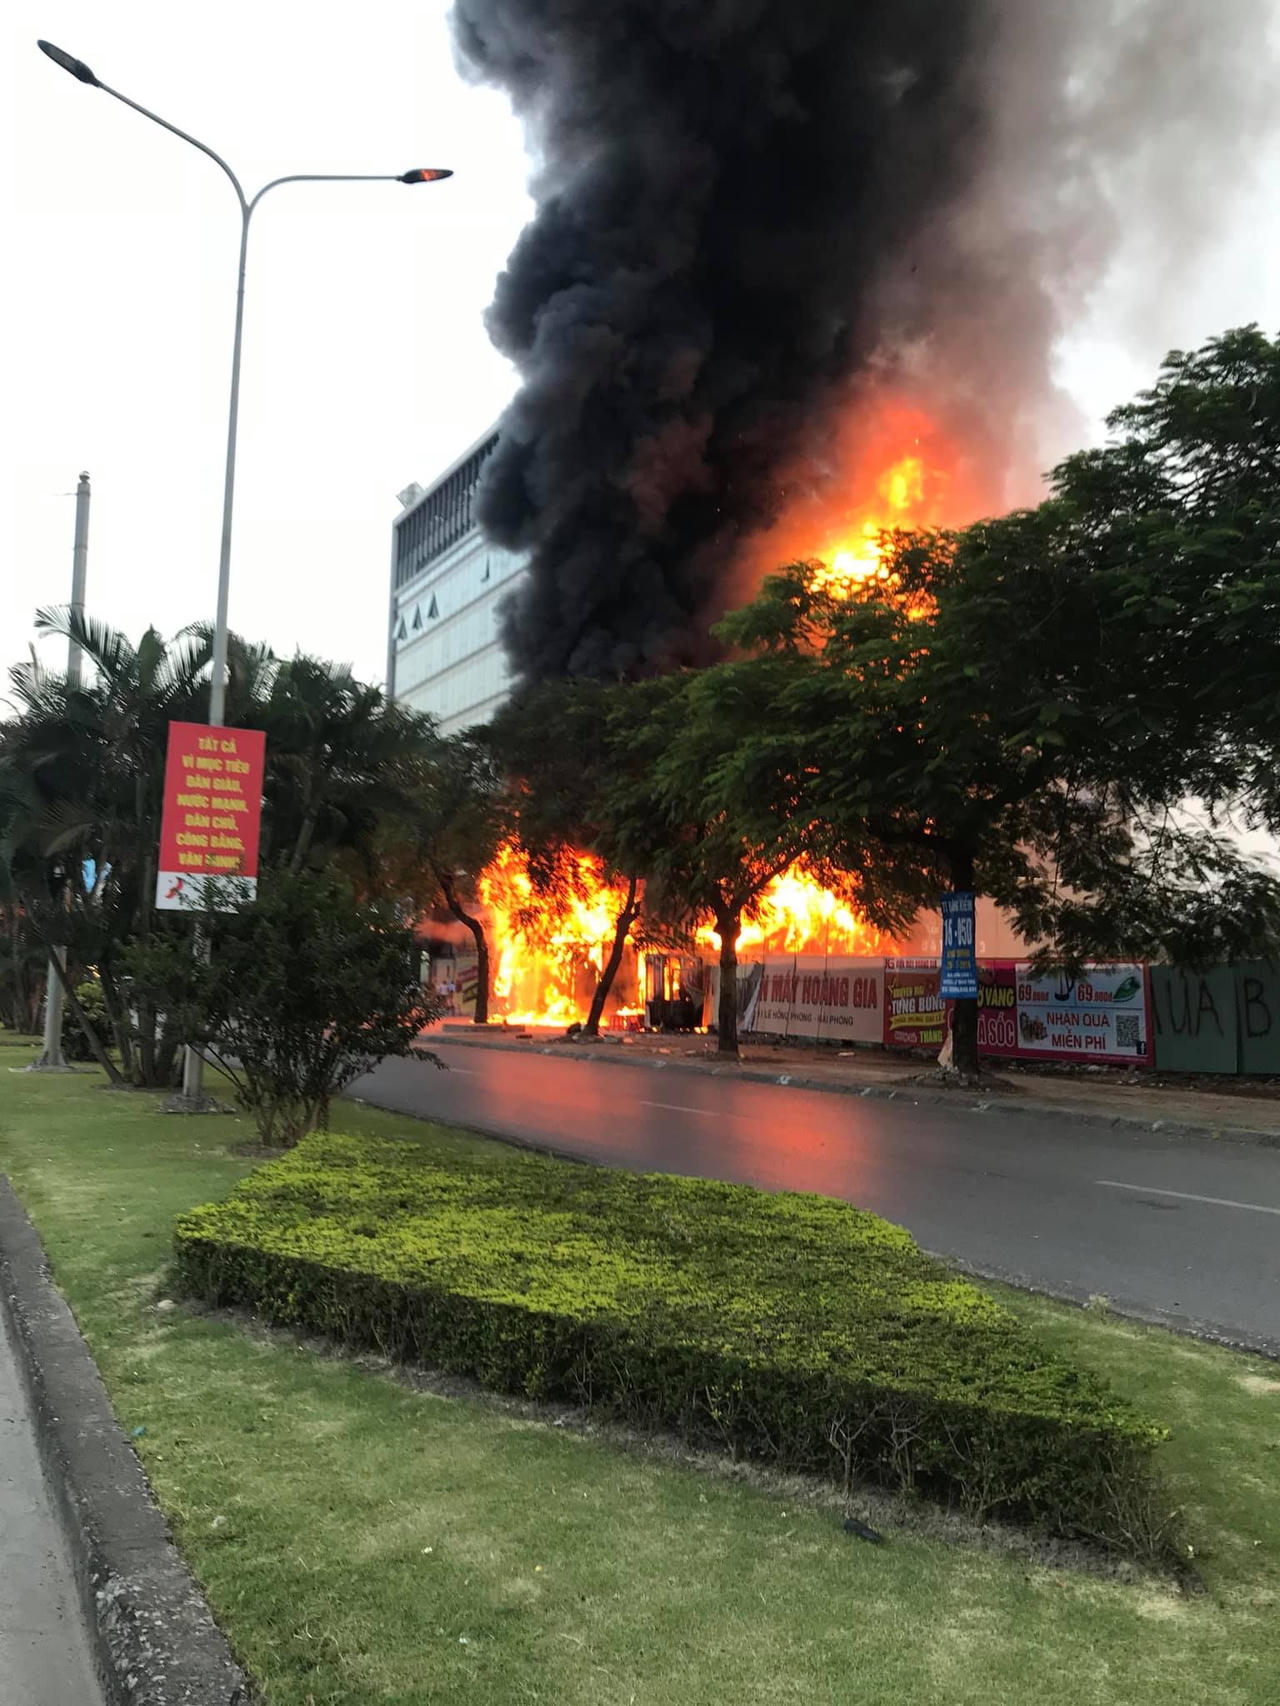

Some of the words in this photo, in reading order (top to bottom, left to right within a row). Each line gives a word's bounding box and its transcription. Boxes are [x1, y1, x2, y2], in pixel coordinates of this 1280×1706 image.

[186, 774, 210, 788] DÂN
[185, 812, 210, 828] DÂN
[771, 970, 798, 1003] MÁY
[802, 972, 849, 1006] HOÀNG
[853, 978, 878, 1008] GIA
[790, 1012, 812, 1022] PHONG
[829, 1012, 854, 1026] PHÒNG
[988, 1011, 1015, 1048] SỐC
[1052, 1028, 1082, 1048] MIỄN
[1085, 1034, 1106, 1049] PHÍ
